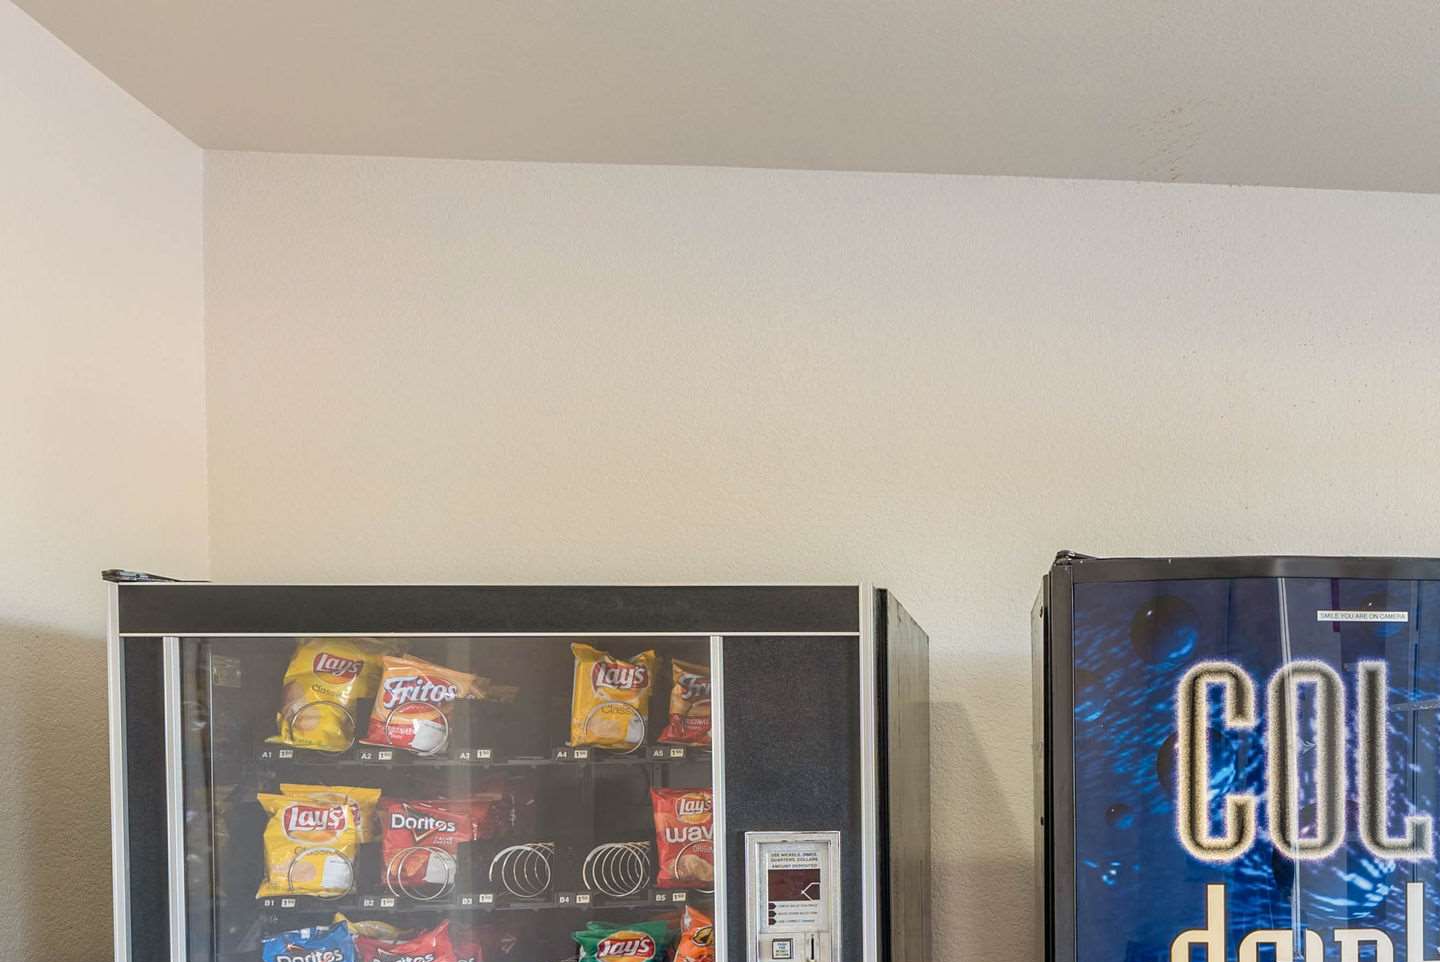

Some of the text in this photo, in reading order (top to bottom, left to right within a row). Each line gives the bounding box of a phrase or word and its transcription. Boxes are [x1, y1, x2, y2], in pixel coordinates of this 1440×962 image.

[384, 675, 457, 708] Fritos
[361, 752, 372, 760] A2
[288, 806, 343, 831] Lay's
[391, 813, 456, 832] Doritos
